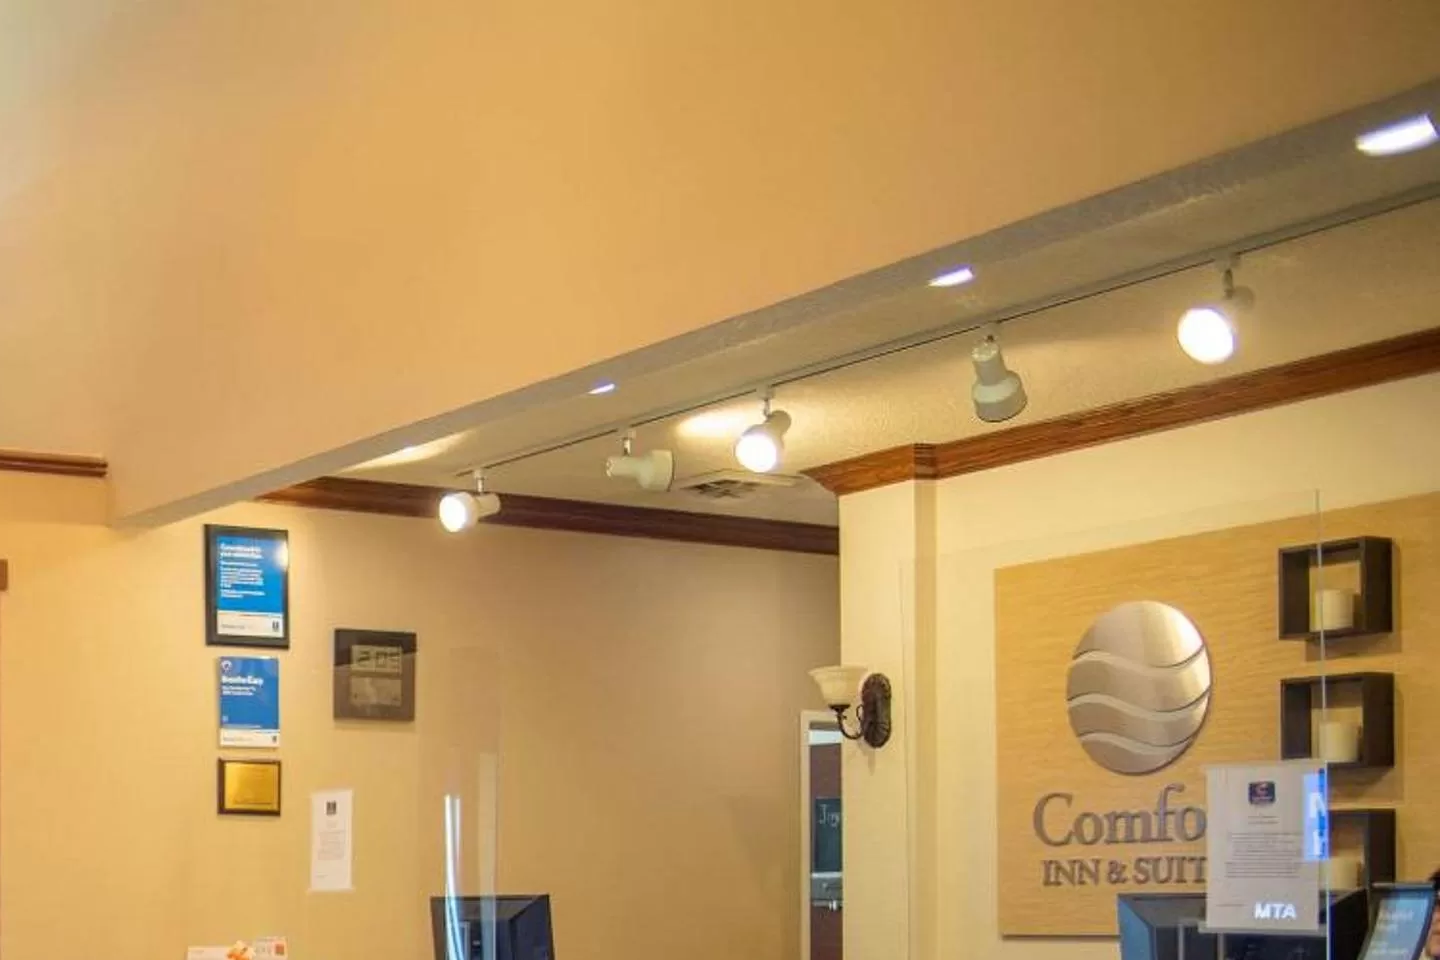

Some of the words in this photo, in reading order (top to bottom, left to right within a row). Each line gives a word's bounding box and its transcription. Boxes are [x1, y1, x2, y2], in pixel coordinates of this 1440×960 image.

[1033, 783, 1208, 847] Comfo
[1042, 858, 1102, 887] INN
[1106, 859, 1129, 885] &
